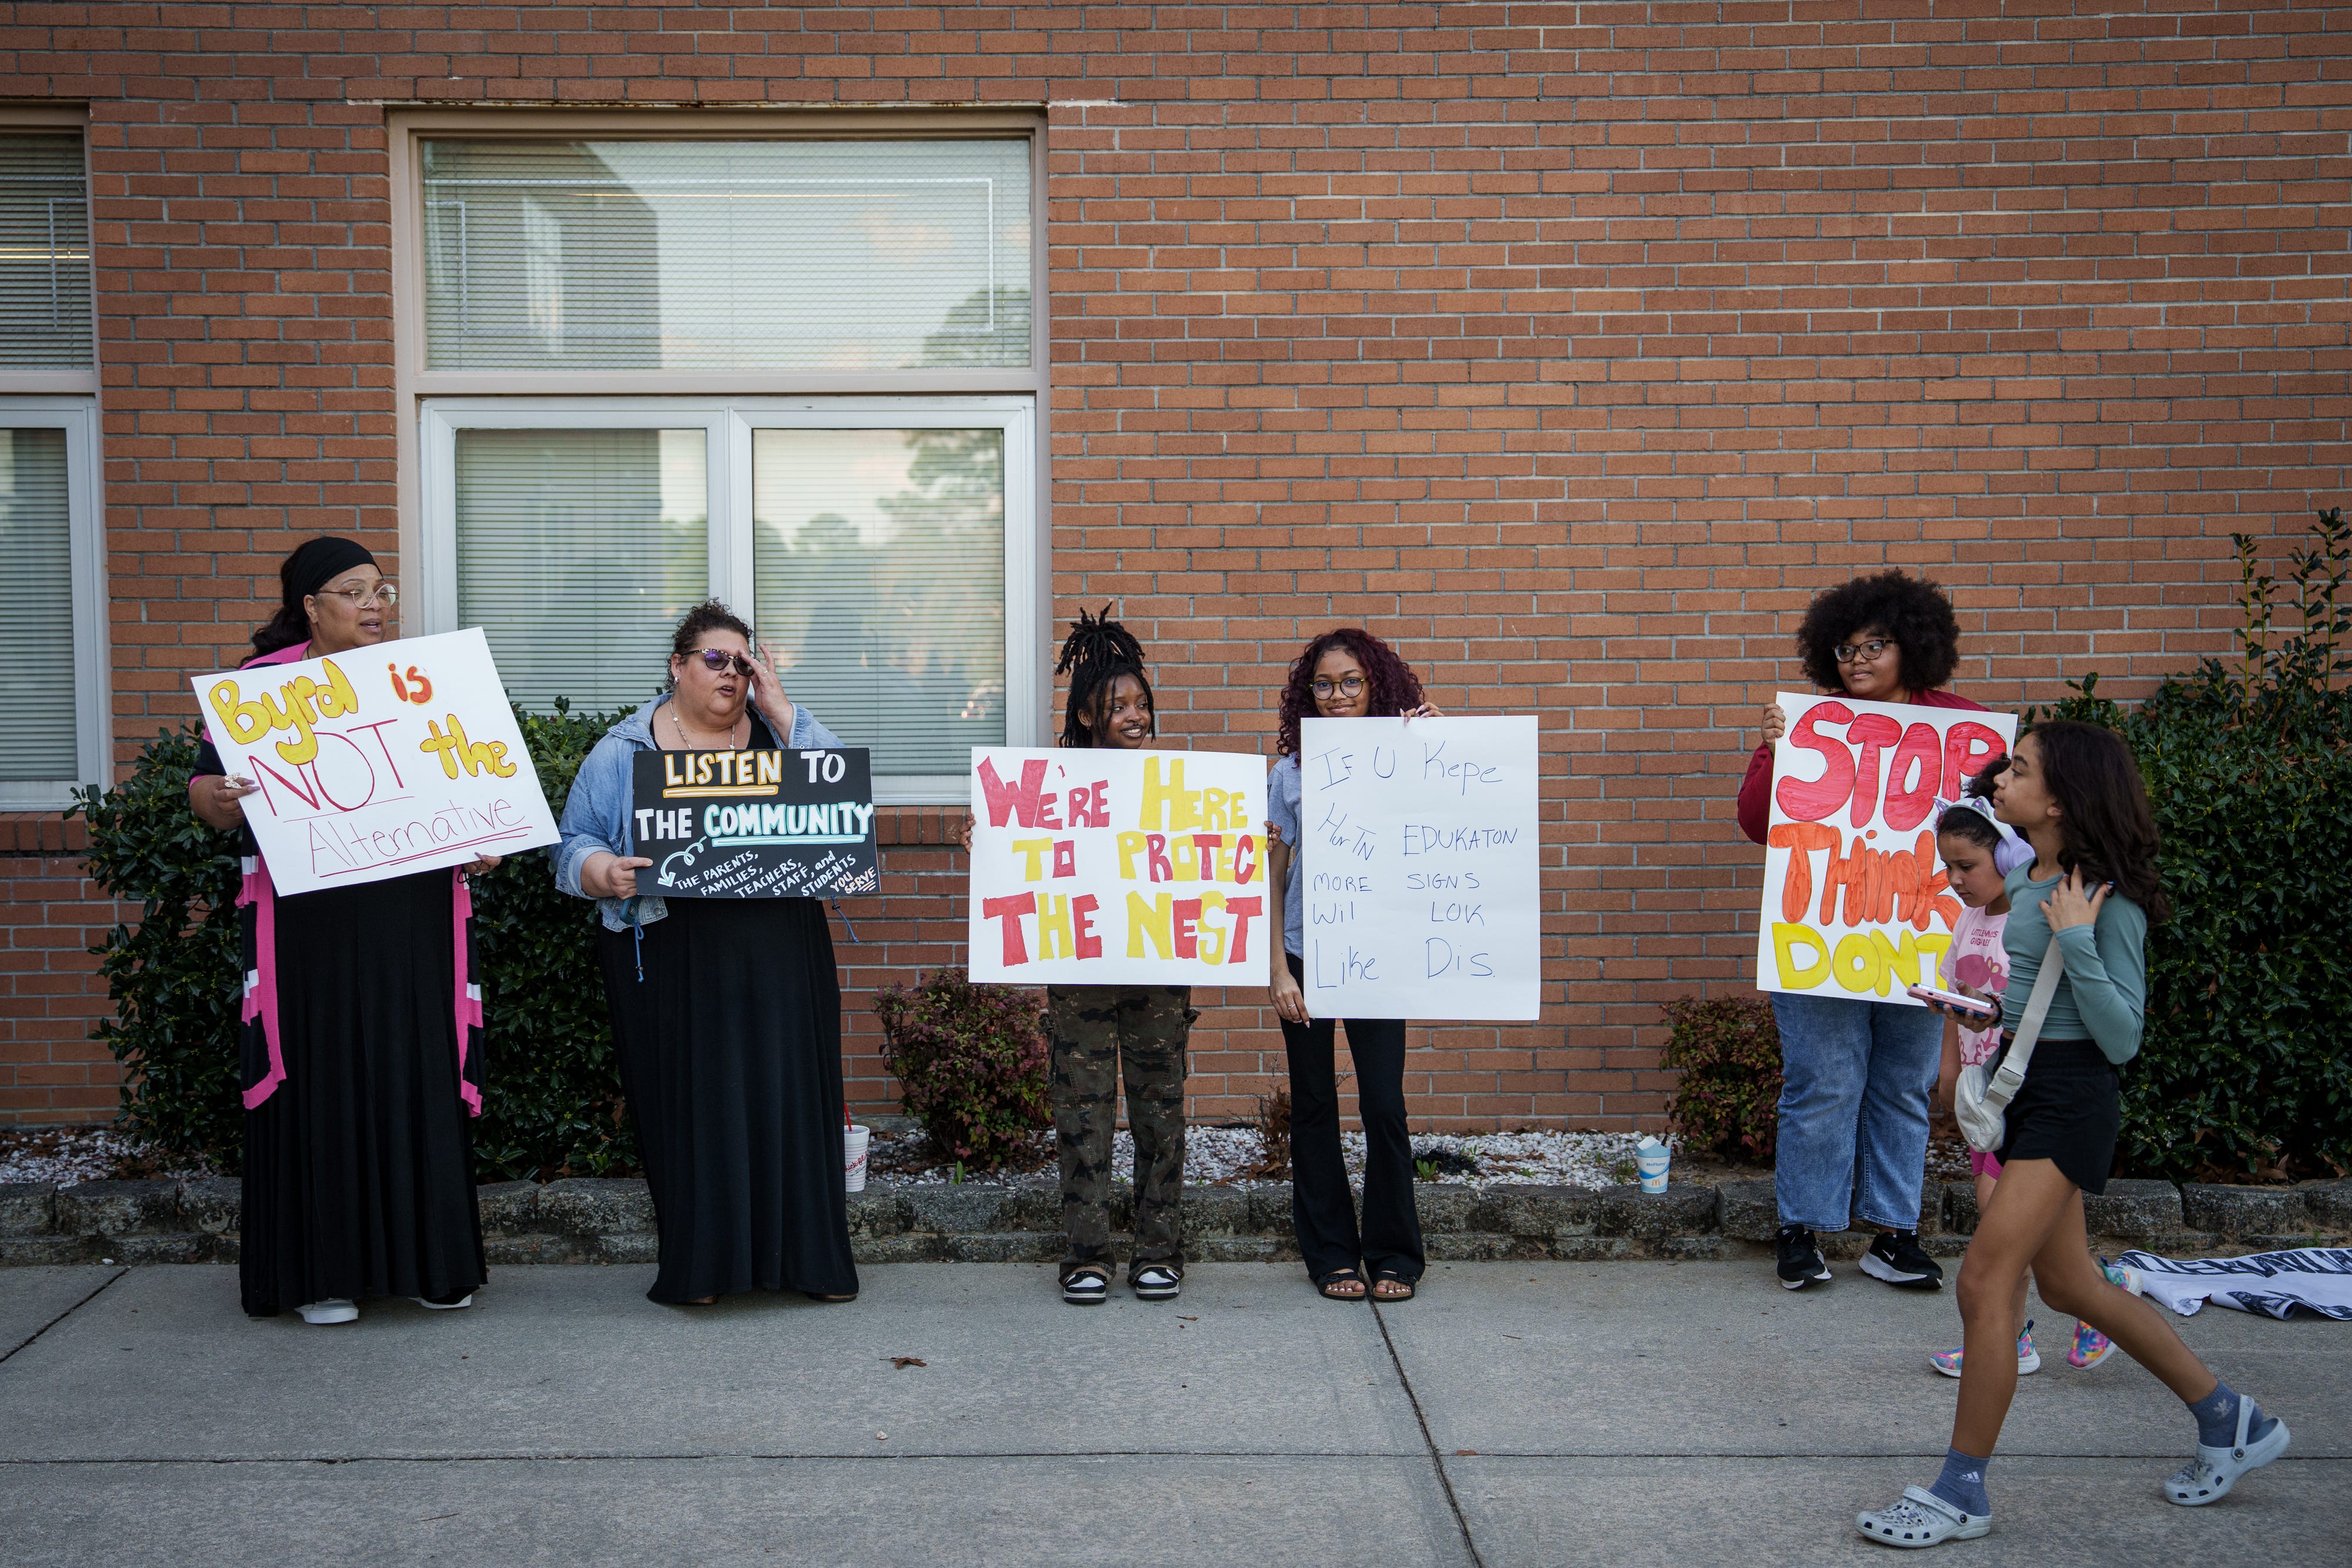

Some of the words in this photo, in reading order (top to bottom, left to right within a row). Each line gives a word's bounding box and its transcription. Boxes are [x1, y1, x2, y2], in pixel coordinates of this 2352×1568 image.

[209, 657, 358, 765] Byrd
[387, 663, 434, 706] is
[249, 719, 404, 817] NOT
[420, 714, 517, 780] the
[664, 750, 781, 786] LISTEN
[800, 750, 846, 783] TO
[1310, 747, 1353, 791] IF
[1374, 746, 1395, 778] U
[1424, 740, 1503, 795] Kepe
[1776, 701, 2007, 832] STOP
[977, 755, 1110, 830] WE'RE
[1140, 755, 1248, 831] HERE
[309, 798, 526, 874] Alternative
[635, 808, 692, 841] THE
[704, 802, 873, 835] COMMUNITY
[1403, 824, 1518, 857] EDUKATON
[674, 875, 700, 890] THE
[703, 850, 759, 881] PARENTS,
[734, 858, 801, 898] TEACHERS,
[772, 865, 815, 896] STAFF,
[815, 850, 836, 870] and
[801, 854, 856, 897] STUDENTS
[1013, 837, 1076, 882] TO
[1116, 830, 1268, 885] PROTECT
[700, 865, 763, 897] FAMILIES,
[830, 871, 853, 892] YOU
[844, 866, 876, 894] SERVE
[1314, 872, 1372, 892] MORE
[1406, 872, 1480, 890] SIGNS
[982, 891, 1102, 967] THE
[1126, 890, 1262, 965] NEST
[1313, 901, 1354, 925] Wil
[1316, 939, 1379, 988] Like
[844, 1151, 867, 1172] hick-fil-
